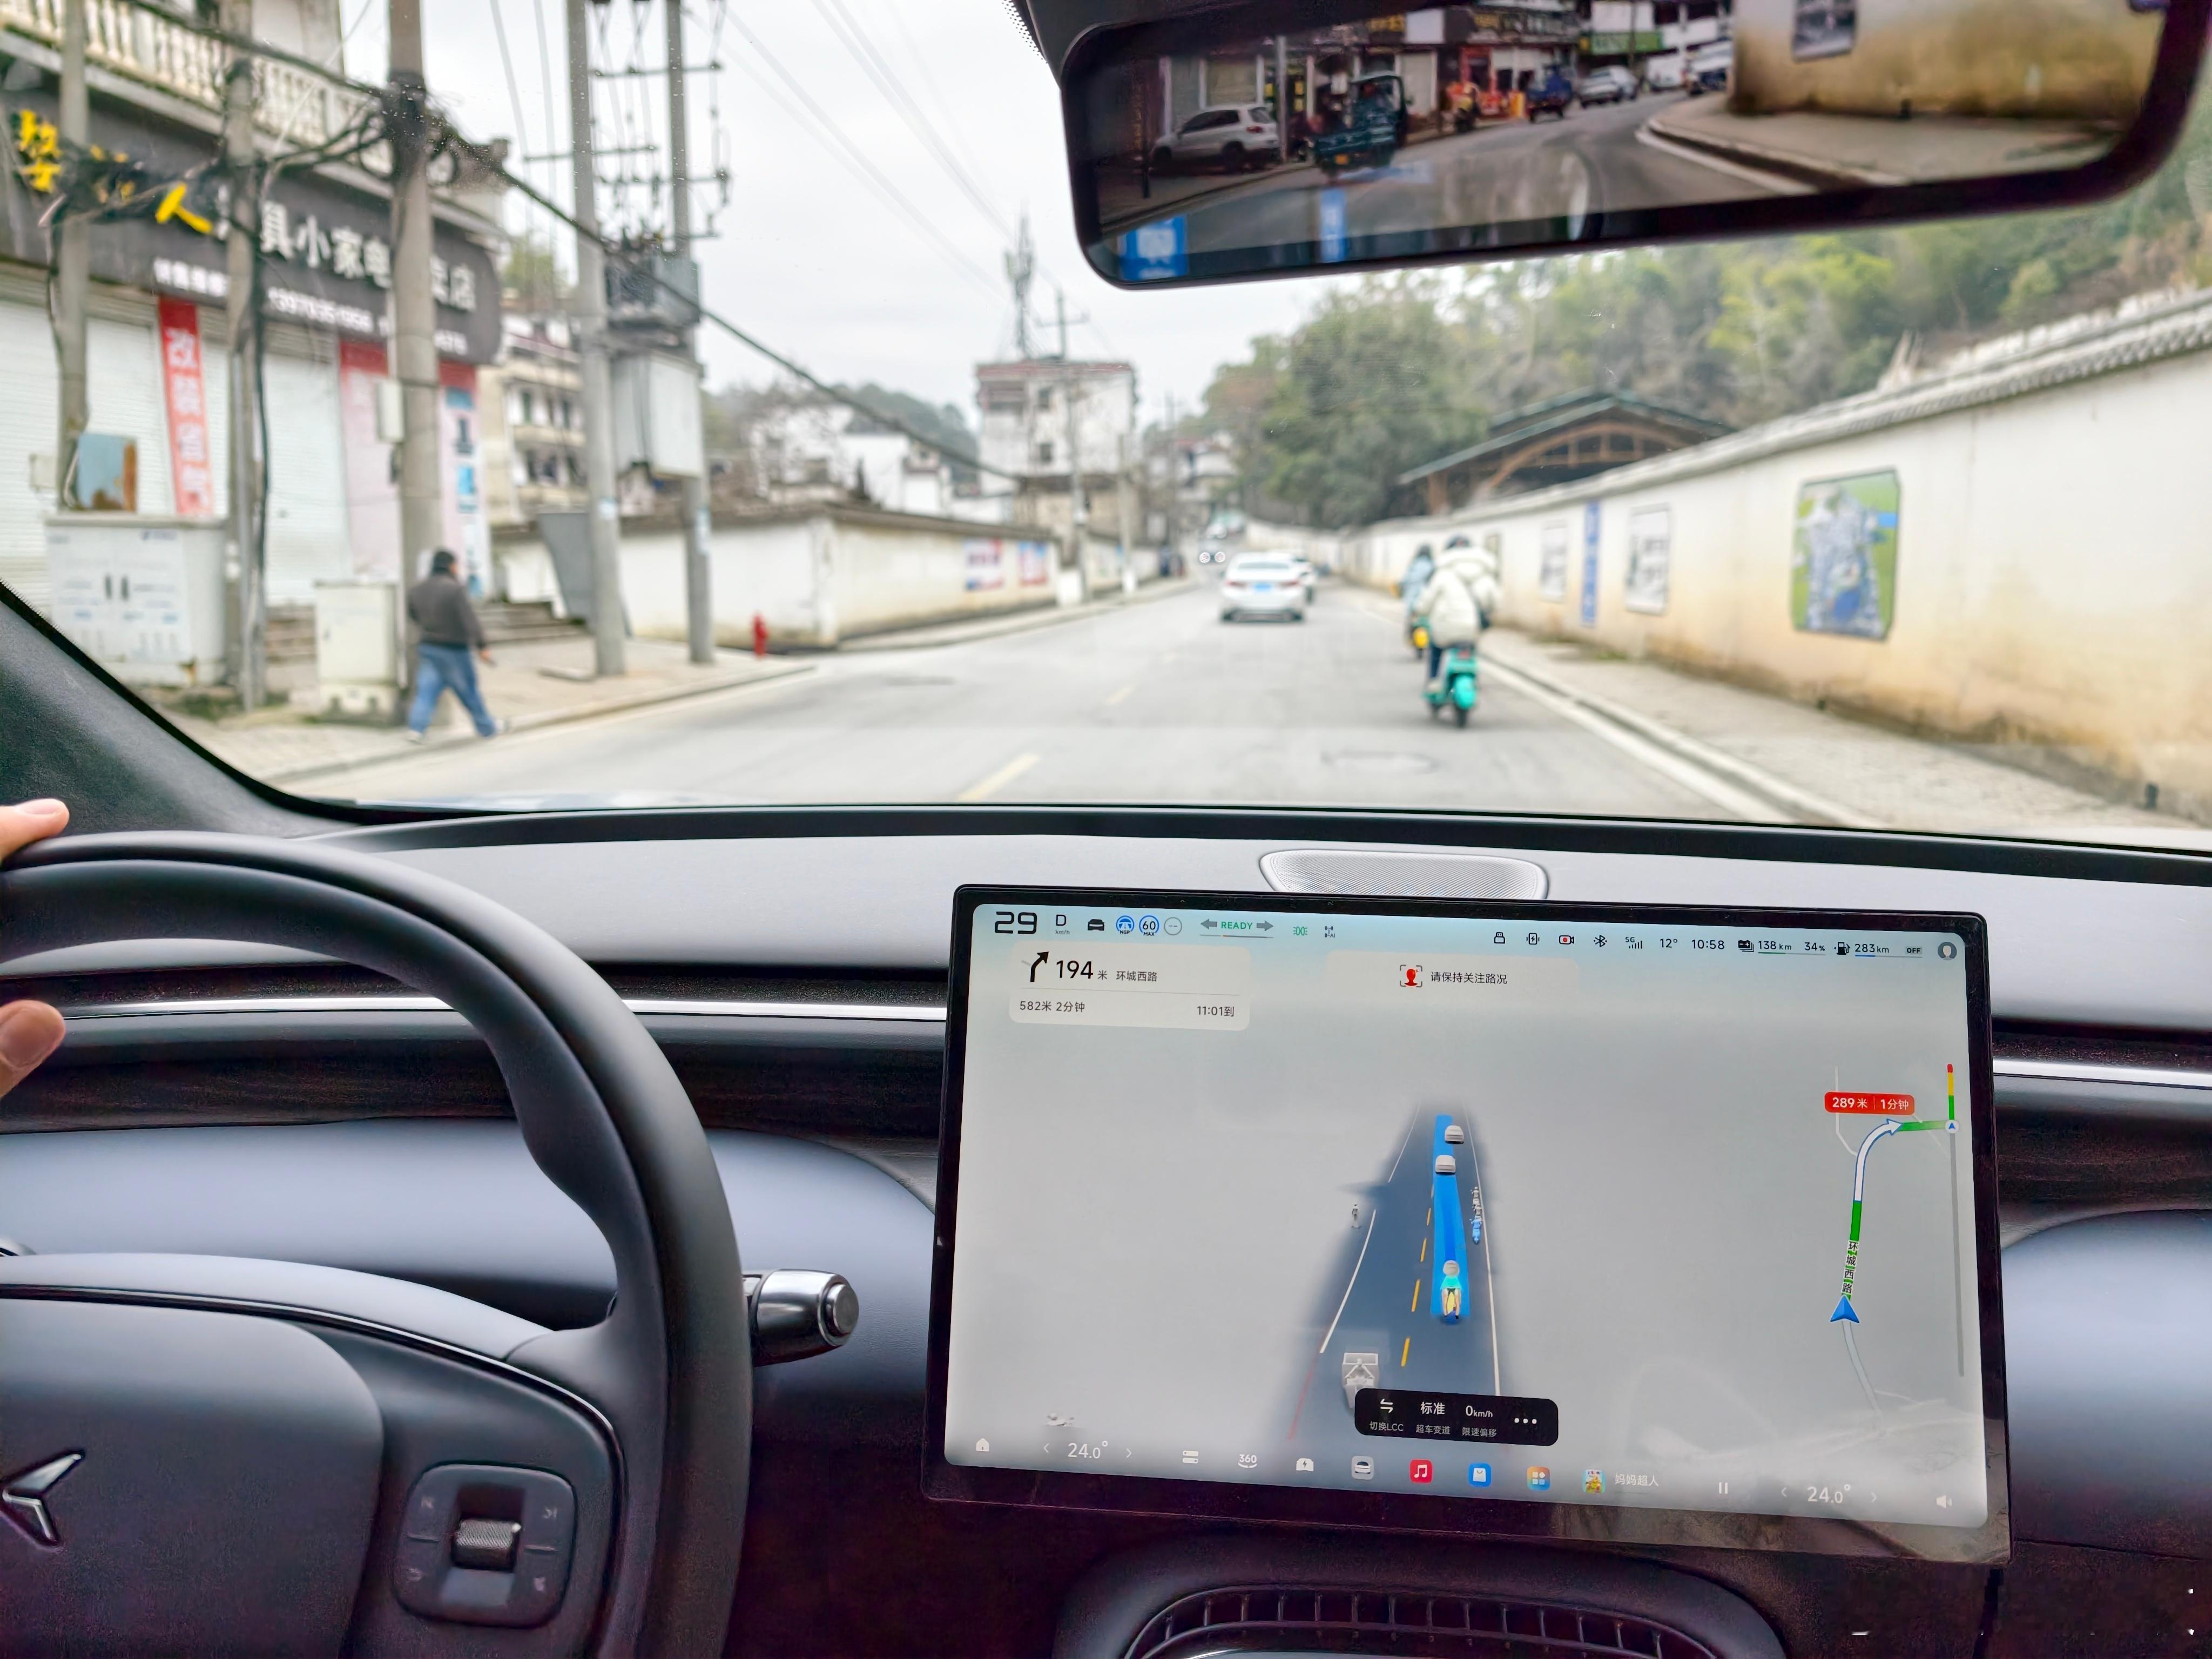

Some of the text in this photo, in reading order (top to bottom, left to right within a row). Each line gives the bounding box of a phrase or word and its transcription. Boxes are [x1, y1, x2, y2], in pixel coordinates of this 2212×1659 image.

[994, 911, 1037, 935] 29
[1056, 914, 1067, 926] D
[1142, 920, 1156, 930] 60
[1220, 921, 1253, 930] READY
[1660, 938, 1678, 949] 12°
[1691, 939, 1725, 950] 10:58
[1804, 942, 1825, 952] 34%
[1056, 960, 1158, 982] 194 米 环城西路
[1430, 972, 1508, 985] 请保持关注路况
[1020, 1000, 1085, 1013] 582米 2分钟
[1197, 1006, 1235, 1017] 11:01到
[1842, 1240, 1859, 1294] 环城西路
[1420, 1401, 1446, 1415] 标准
[1369, 1421, 1404, 1432] 切换LCC
[1415, 1424, 1451, 1435] 超车变道
[1461, 1426, 1498, 1438] 限速偏移
[1067, 1440, 1109, 1459] 24.0°
[1239, 1454, 1257, 1464] 360
[1615, 1473, 1660, 1487] 妈妈超人
[1807, 1483, 1851, 1503] 24.0°
